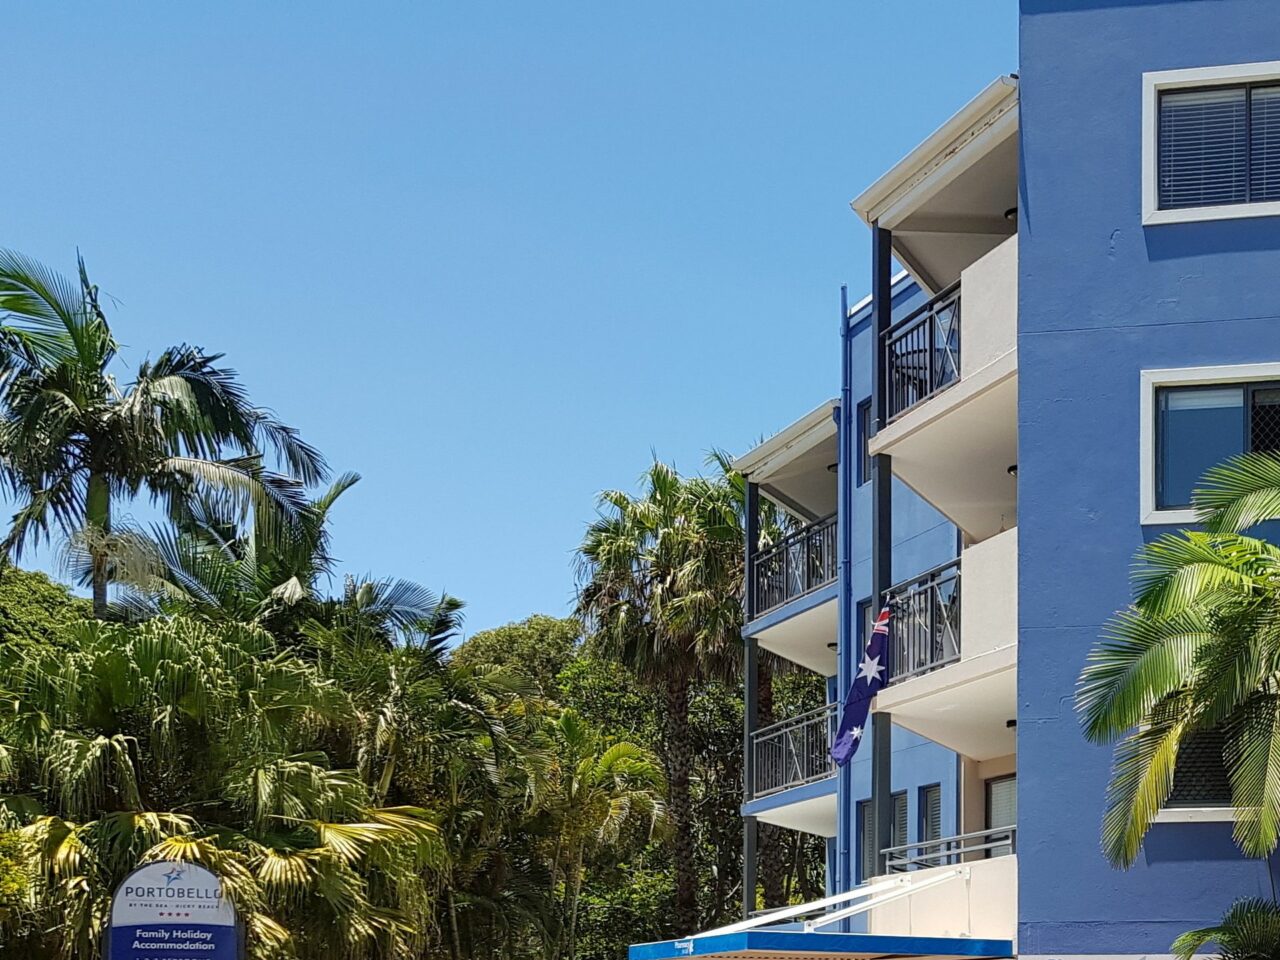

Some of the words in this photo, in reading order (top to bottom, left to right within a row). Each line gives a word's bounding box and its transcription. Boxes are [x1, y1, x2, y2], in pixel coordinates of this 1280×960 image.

[125, 886, 223, 899] PORTOBELLO
[136, 929, 170, 941] Family
[172, 929, 213, 941] Holiday
[132, 940, 215, 950] Accommodation
